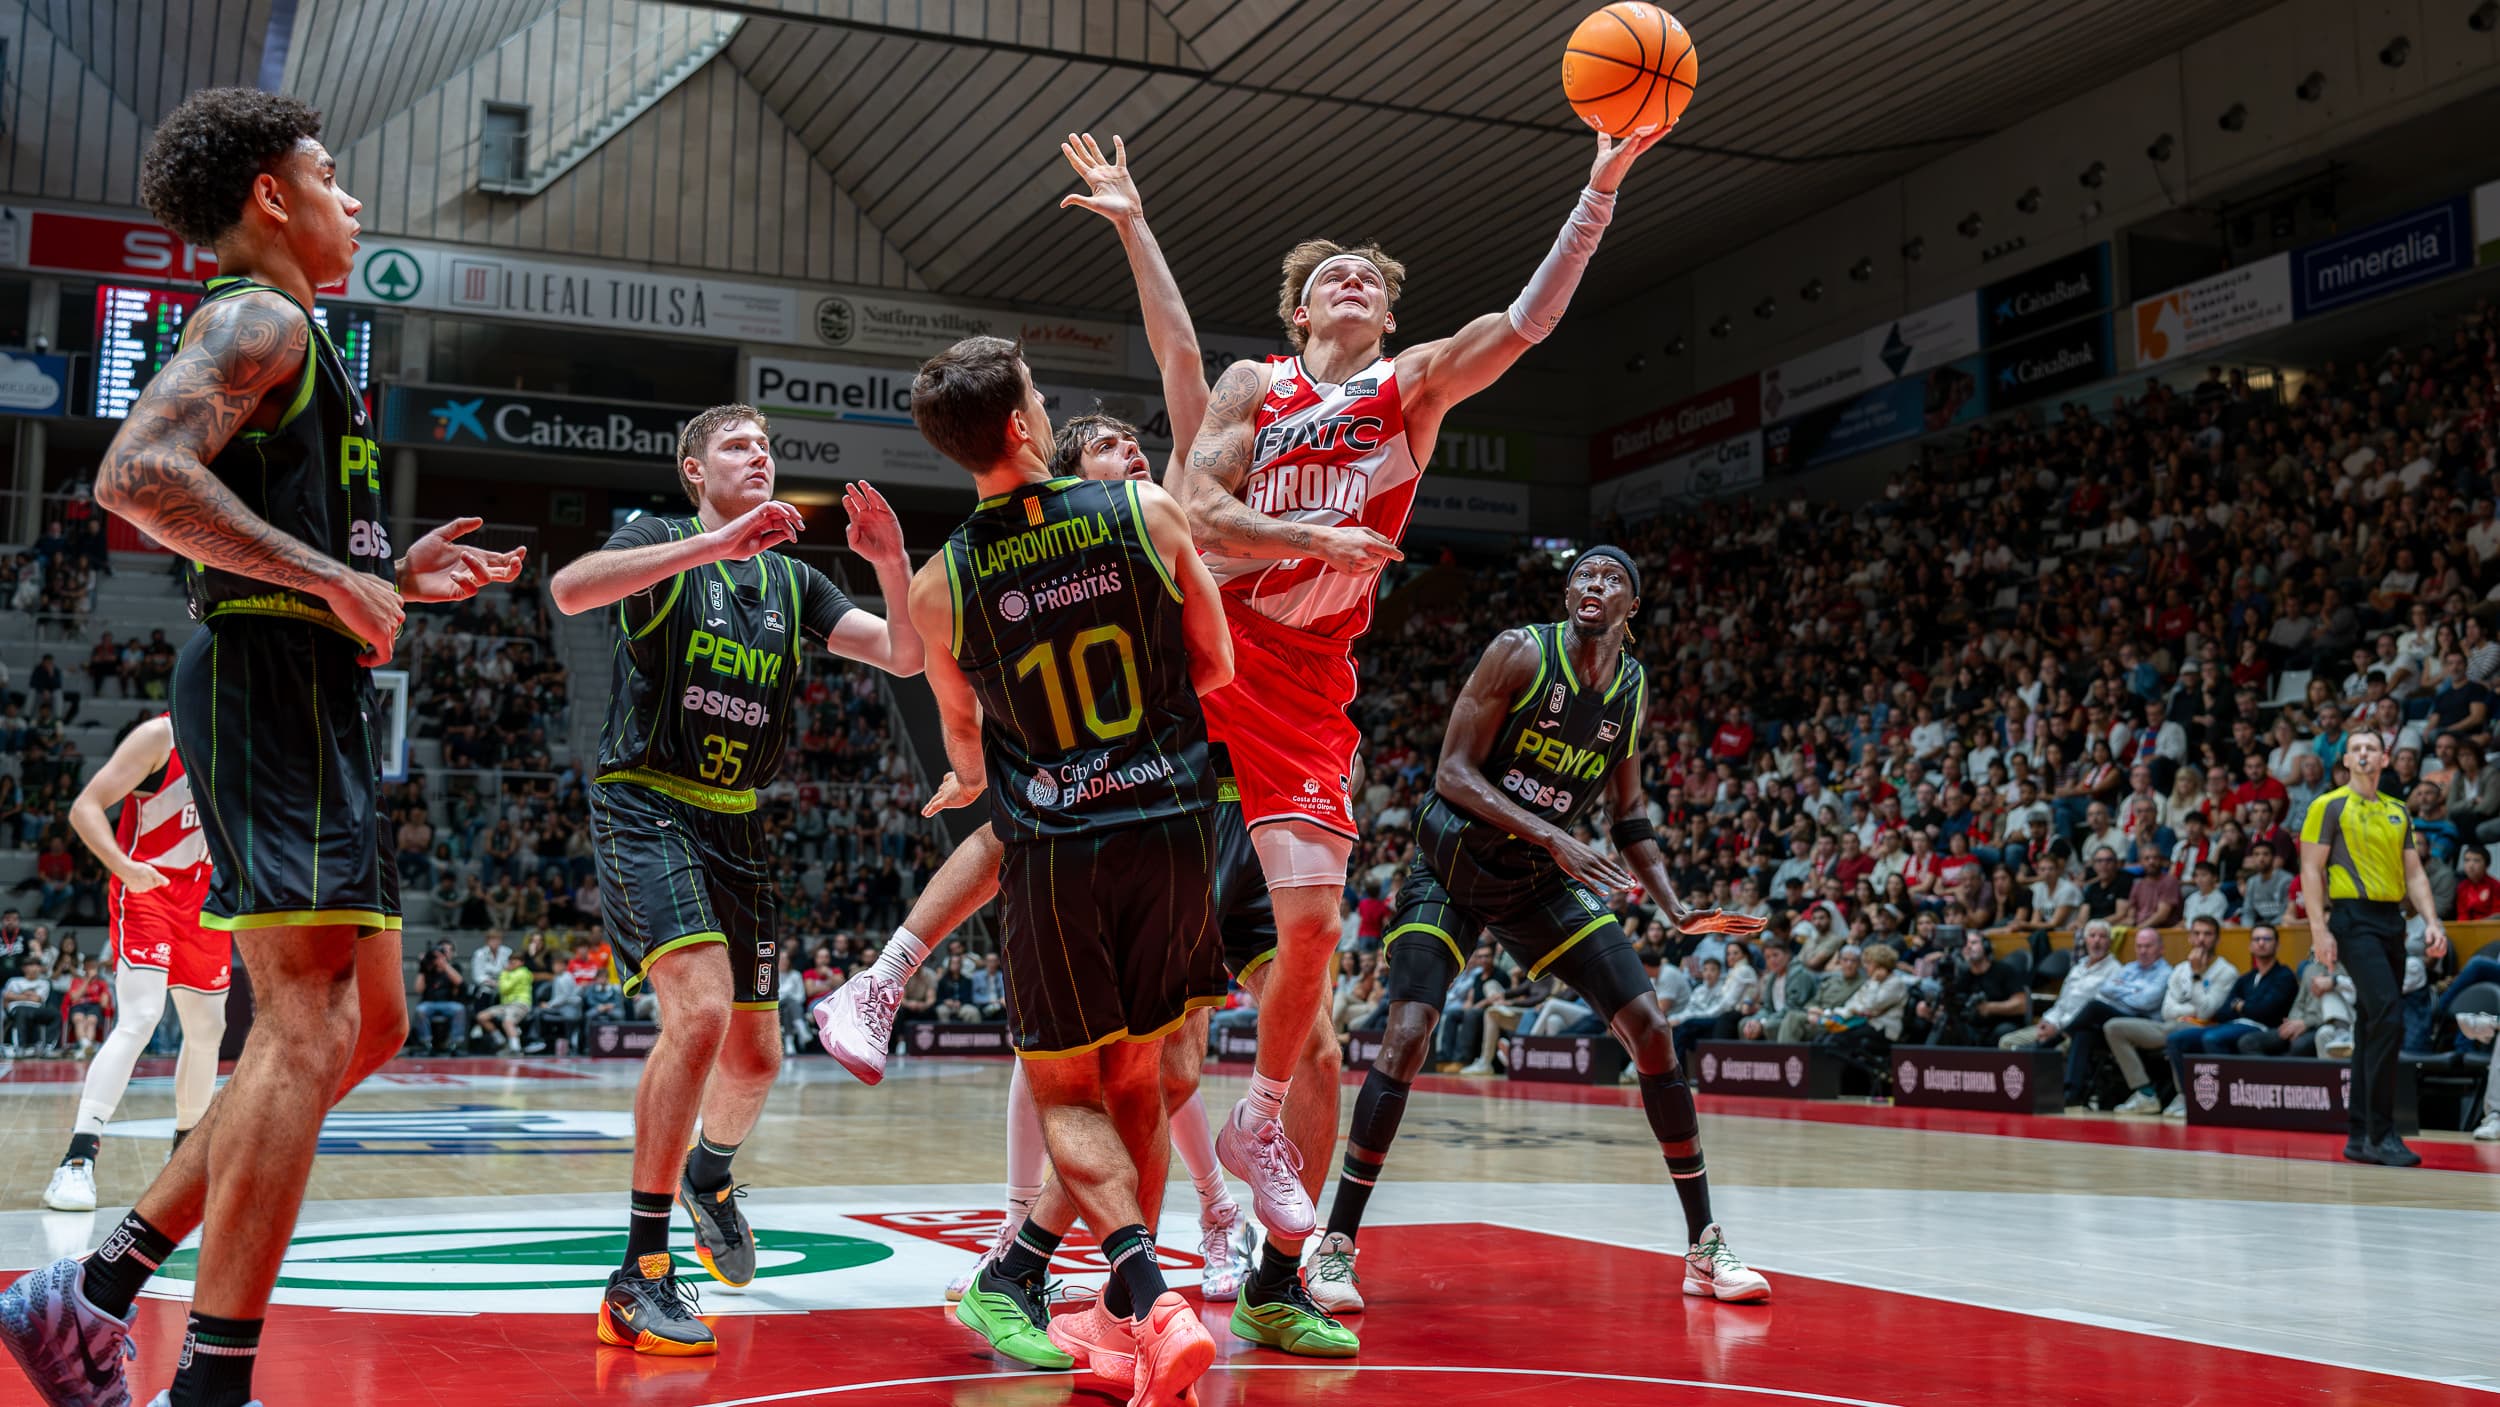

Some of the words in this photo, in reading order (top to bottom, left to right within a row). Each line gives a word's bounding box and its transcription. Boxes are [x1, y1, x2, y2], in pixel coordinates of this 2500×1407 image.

[2317, 229, 2440, 293] mineralia
[505, 270, 596, 318] LLEAL
[608, 281, 706, 328] TULSÀ
[2015, 273, 2092, 318] CaixaBank
[2017, 341, 2096, 384] CaixaBank
[1254, 415, 1383, 463] FIATC
[1612, 421, 1653, 459] Diari
[1654, 415, 1676, 444] de
[1678, 396, 1736, 435] Girona
[1435, 432, 1506, 473] TIU
[1246, 463, 1369, 525] GIRONA
[1468, 497, 1518, 514] Girona
[974, 512, 1112, 578] LAPROVITTOLA
[1031, 562, 1118, 592] FUNDACIÓN
[1033, 571, 1122, 613] PROBITAS
[684, 629, 783, 687] PENYA
[683, 685, 769, 728] asisa
[1015, 624, 1144, 751] 10
[700, 734, 749, 786] 35
[1060, 762, 1090, 783] City
[1093, 751, 1110, 771] of
[1514, 728, 1606, 780] PENYA
[1062, 755, 1175, 808] BADALONA
[1292, 795, 1310, 803] Costa
[1312, 796, 1330, 804] Brava
[1503, 768, 1573, 813] asisa
[1317, 803, 1336, 811] Girona
[2229, 1078, 2282, 1110] BÀSQUET
[2283, 1085, 2331, 1111] GIRONA
